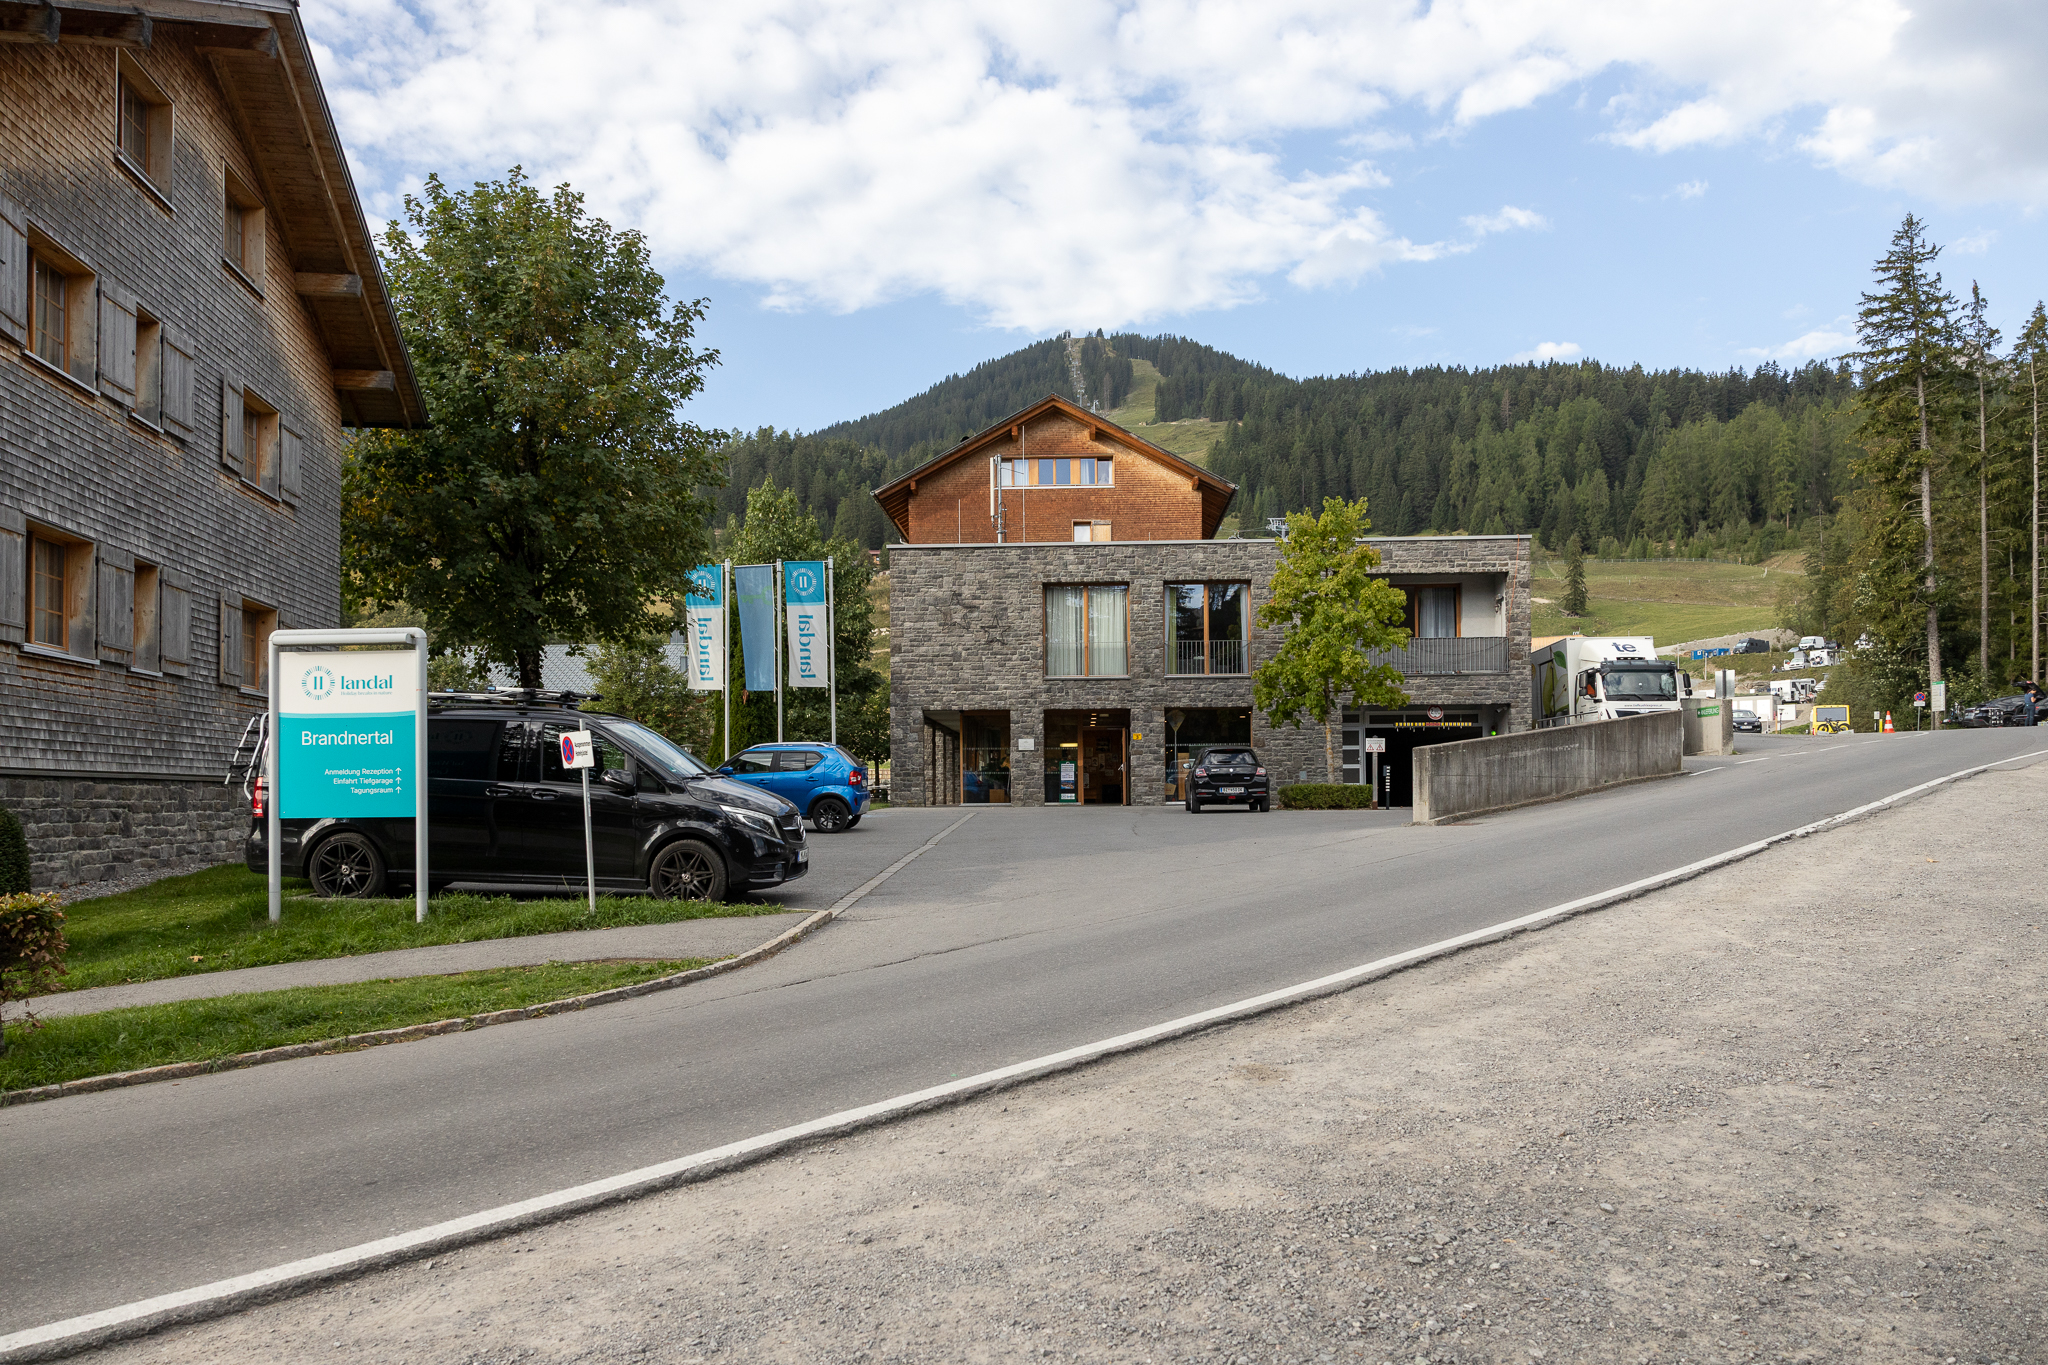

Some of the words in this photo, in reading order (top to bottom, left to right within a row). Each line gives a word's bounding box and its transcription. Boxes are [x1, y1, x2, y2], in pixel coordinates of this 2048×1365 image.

[698, 617, 714, 680] landal
[798, 614, 816, 678] landal
[1611, 642, 1637, 652] te
[340, 675, 393, 690] landal
[301, 730, 393, 746] Brandnertal
[324, 768, 360, 776] Anmeldung
[359, 777, 393, 785] Tiefgarage
[350, 787, 393, 795] Tagungsraum
